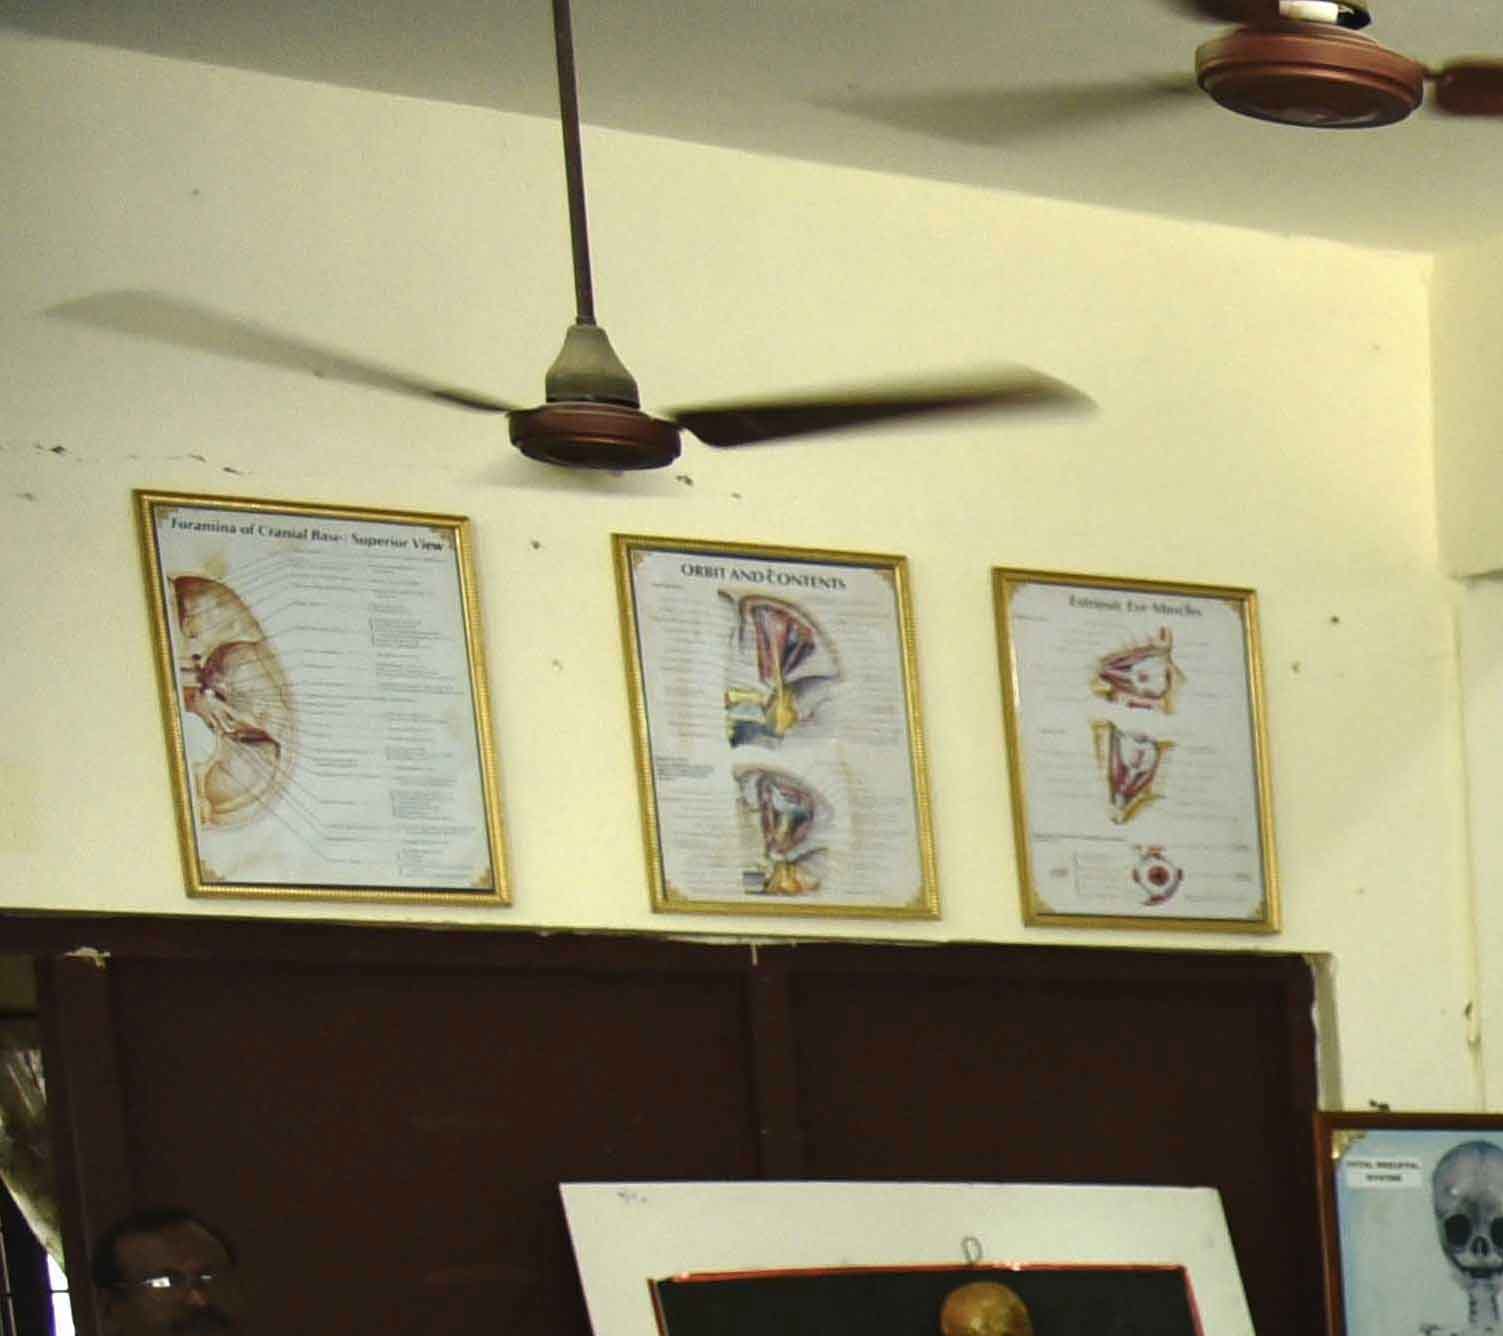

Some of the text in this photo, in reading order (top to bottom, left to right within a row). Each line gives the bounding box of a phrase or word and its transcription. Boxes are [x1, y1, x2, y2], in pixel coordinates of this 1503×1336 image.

[170, 516, 238, 536] Foramina
[240, 522, 255, 537] of
[257, 525, 309, 542] Cranial
[351, 533, 409, 550] Superior
[413, 535, 445, 552] View
[680, 562, 847, 590] ORBIT AND CONTENTS
